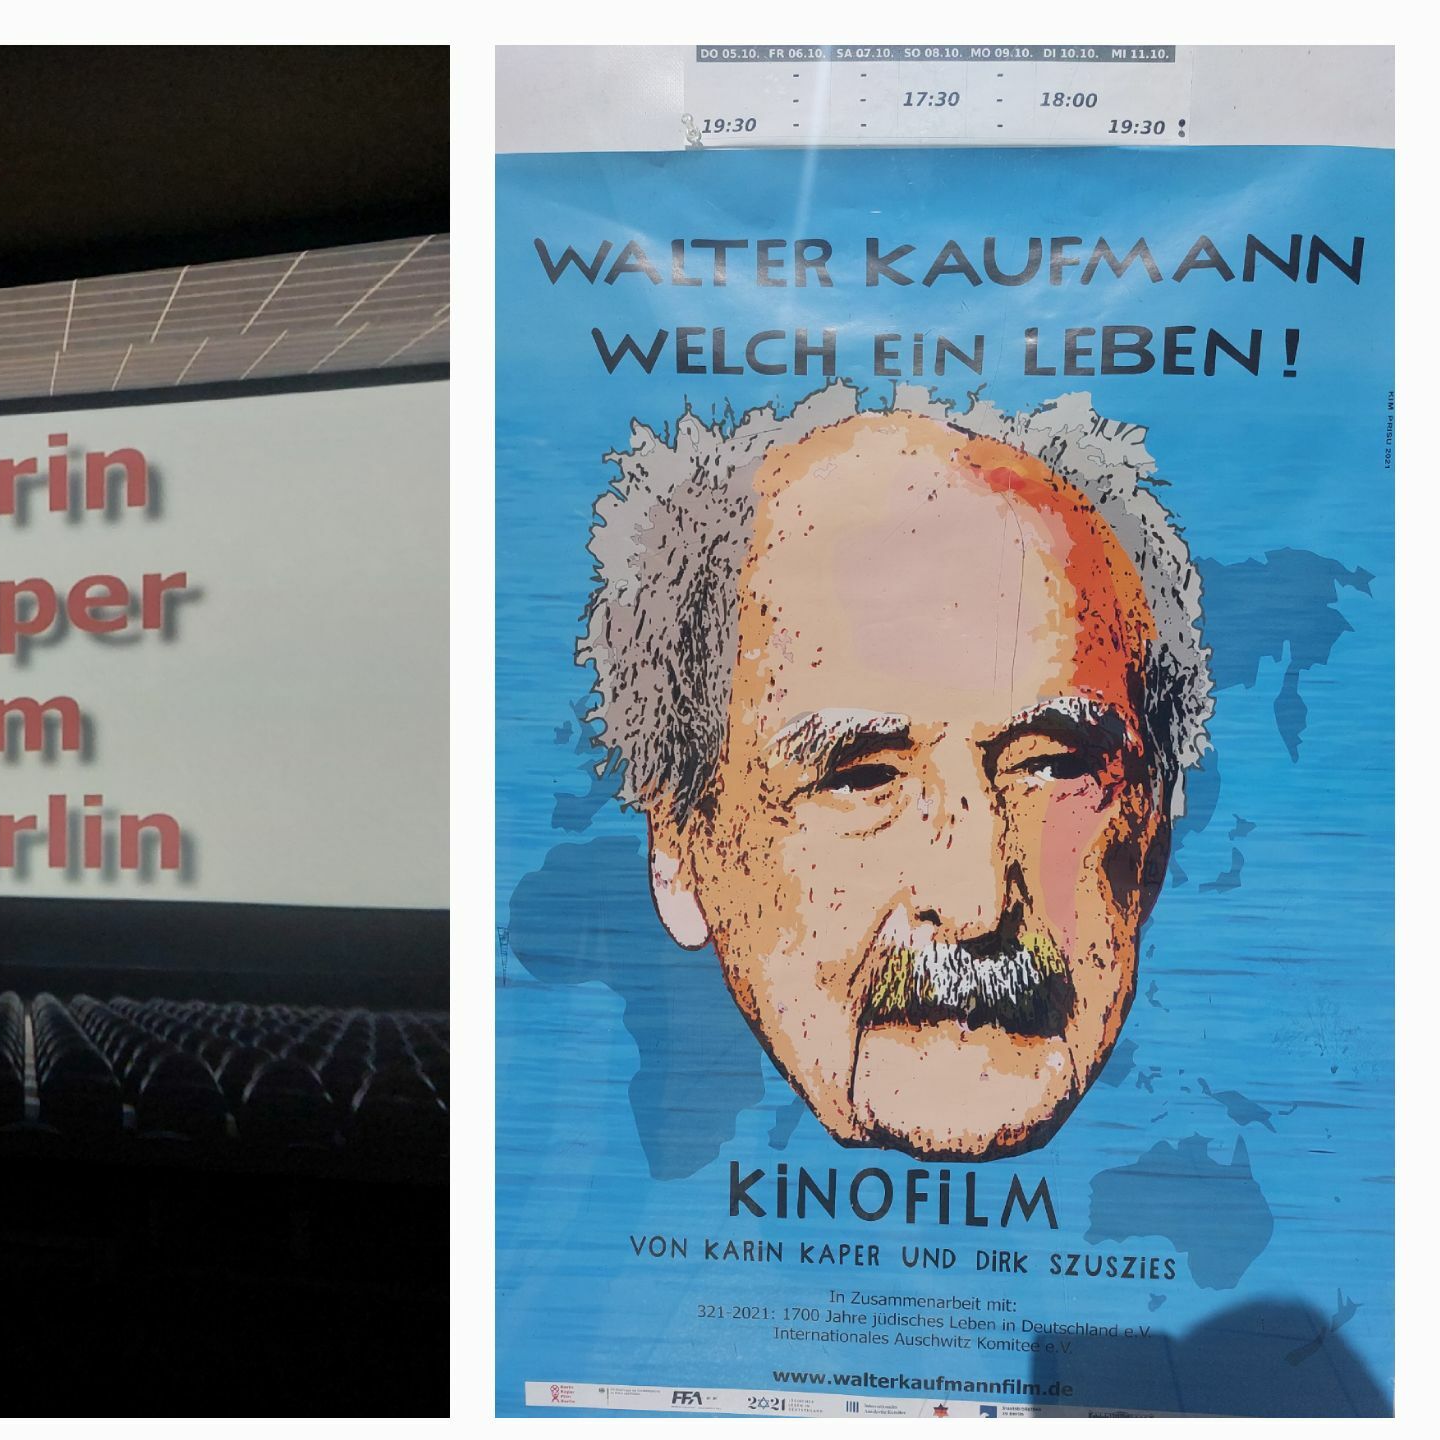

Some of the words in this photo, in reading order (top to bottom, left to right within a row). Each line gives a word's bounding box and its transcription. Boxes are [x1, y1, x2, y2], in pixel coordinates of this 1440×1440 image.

[700, 48, 719, 59] DO
[722, 48, 760, 59] 05.10.
[769, 48, 786, 59] FR
[788, 48, 827, 59] 06.10.
[836, 48, 853, 59] SA
[856, 48, 895, 59] 07.10.
[904, 48, 922, 59] SO
[924, 48, 963, 59] 08.10.
[970, 48, 991, 59] MO
[993, 48, 1034, 59] 09.10.
[1043, 48, 1057, 59] DI
[1060, 48, 1100, 59] 10.10.
[1111, 48, 1128, 60] MI
[1130, 48, 1170, 60] 11.10.
[902, 91, 961, 107] 17:30
[1040, 91, 1098, 108] 18:00
[700, 117, 757, 134] 19:30
[1107, 119, 1165, 135] 19:30
[533, 236, 834, 288] WALTER
[864, 234, 1364, 288] KAUFMANN
[591, 326, 835, 377] WELCH
[629, 1235, 688, 1259] VON
[800, 1242, 881, 1267] KAPER
[901, 1246, 957, 1270] UND
[829, 1290, 845, 1304] In
[850, 1291, 982, 1311] Zusammenarbeit
[986, 1298, 1017, 1313] mit:
[697, 1304, 776, 1320] 321-2021:
[783, 1307, 820, 1322] 1700
[825, 1309, 868, 1325] Jahre
[871, 1312, 944, 1329] jüdisches
[949, 1315, 997, 1331] Leben
[1002, 1318, 1016, 1332] in
[1021, 1319, 1119, 1337] Deutschland
[1124, 1325, 1152, 1338] e.V.
[773, 1326, 890, 1345] Internationales
[894, 1331, 972, 1349] Auschwitz
[977, 1337, 1040, 1352] Komitee
[1045, 1341, 1073, 1355] e.V.
[671, 1390, 703, 1406] FFA
[771, 1370, 1074, 1398] www.walterkaufmannfilm.de
